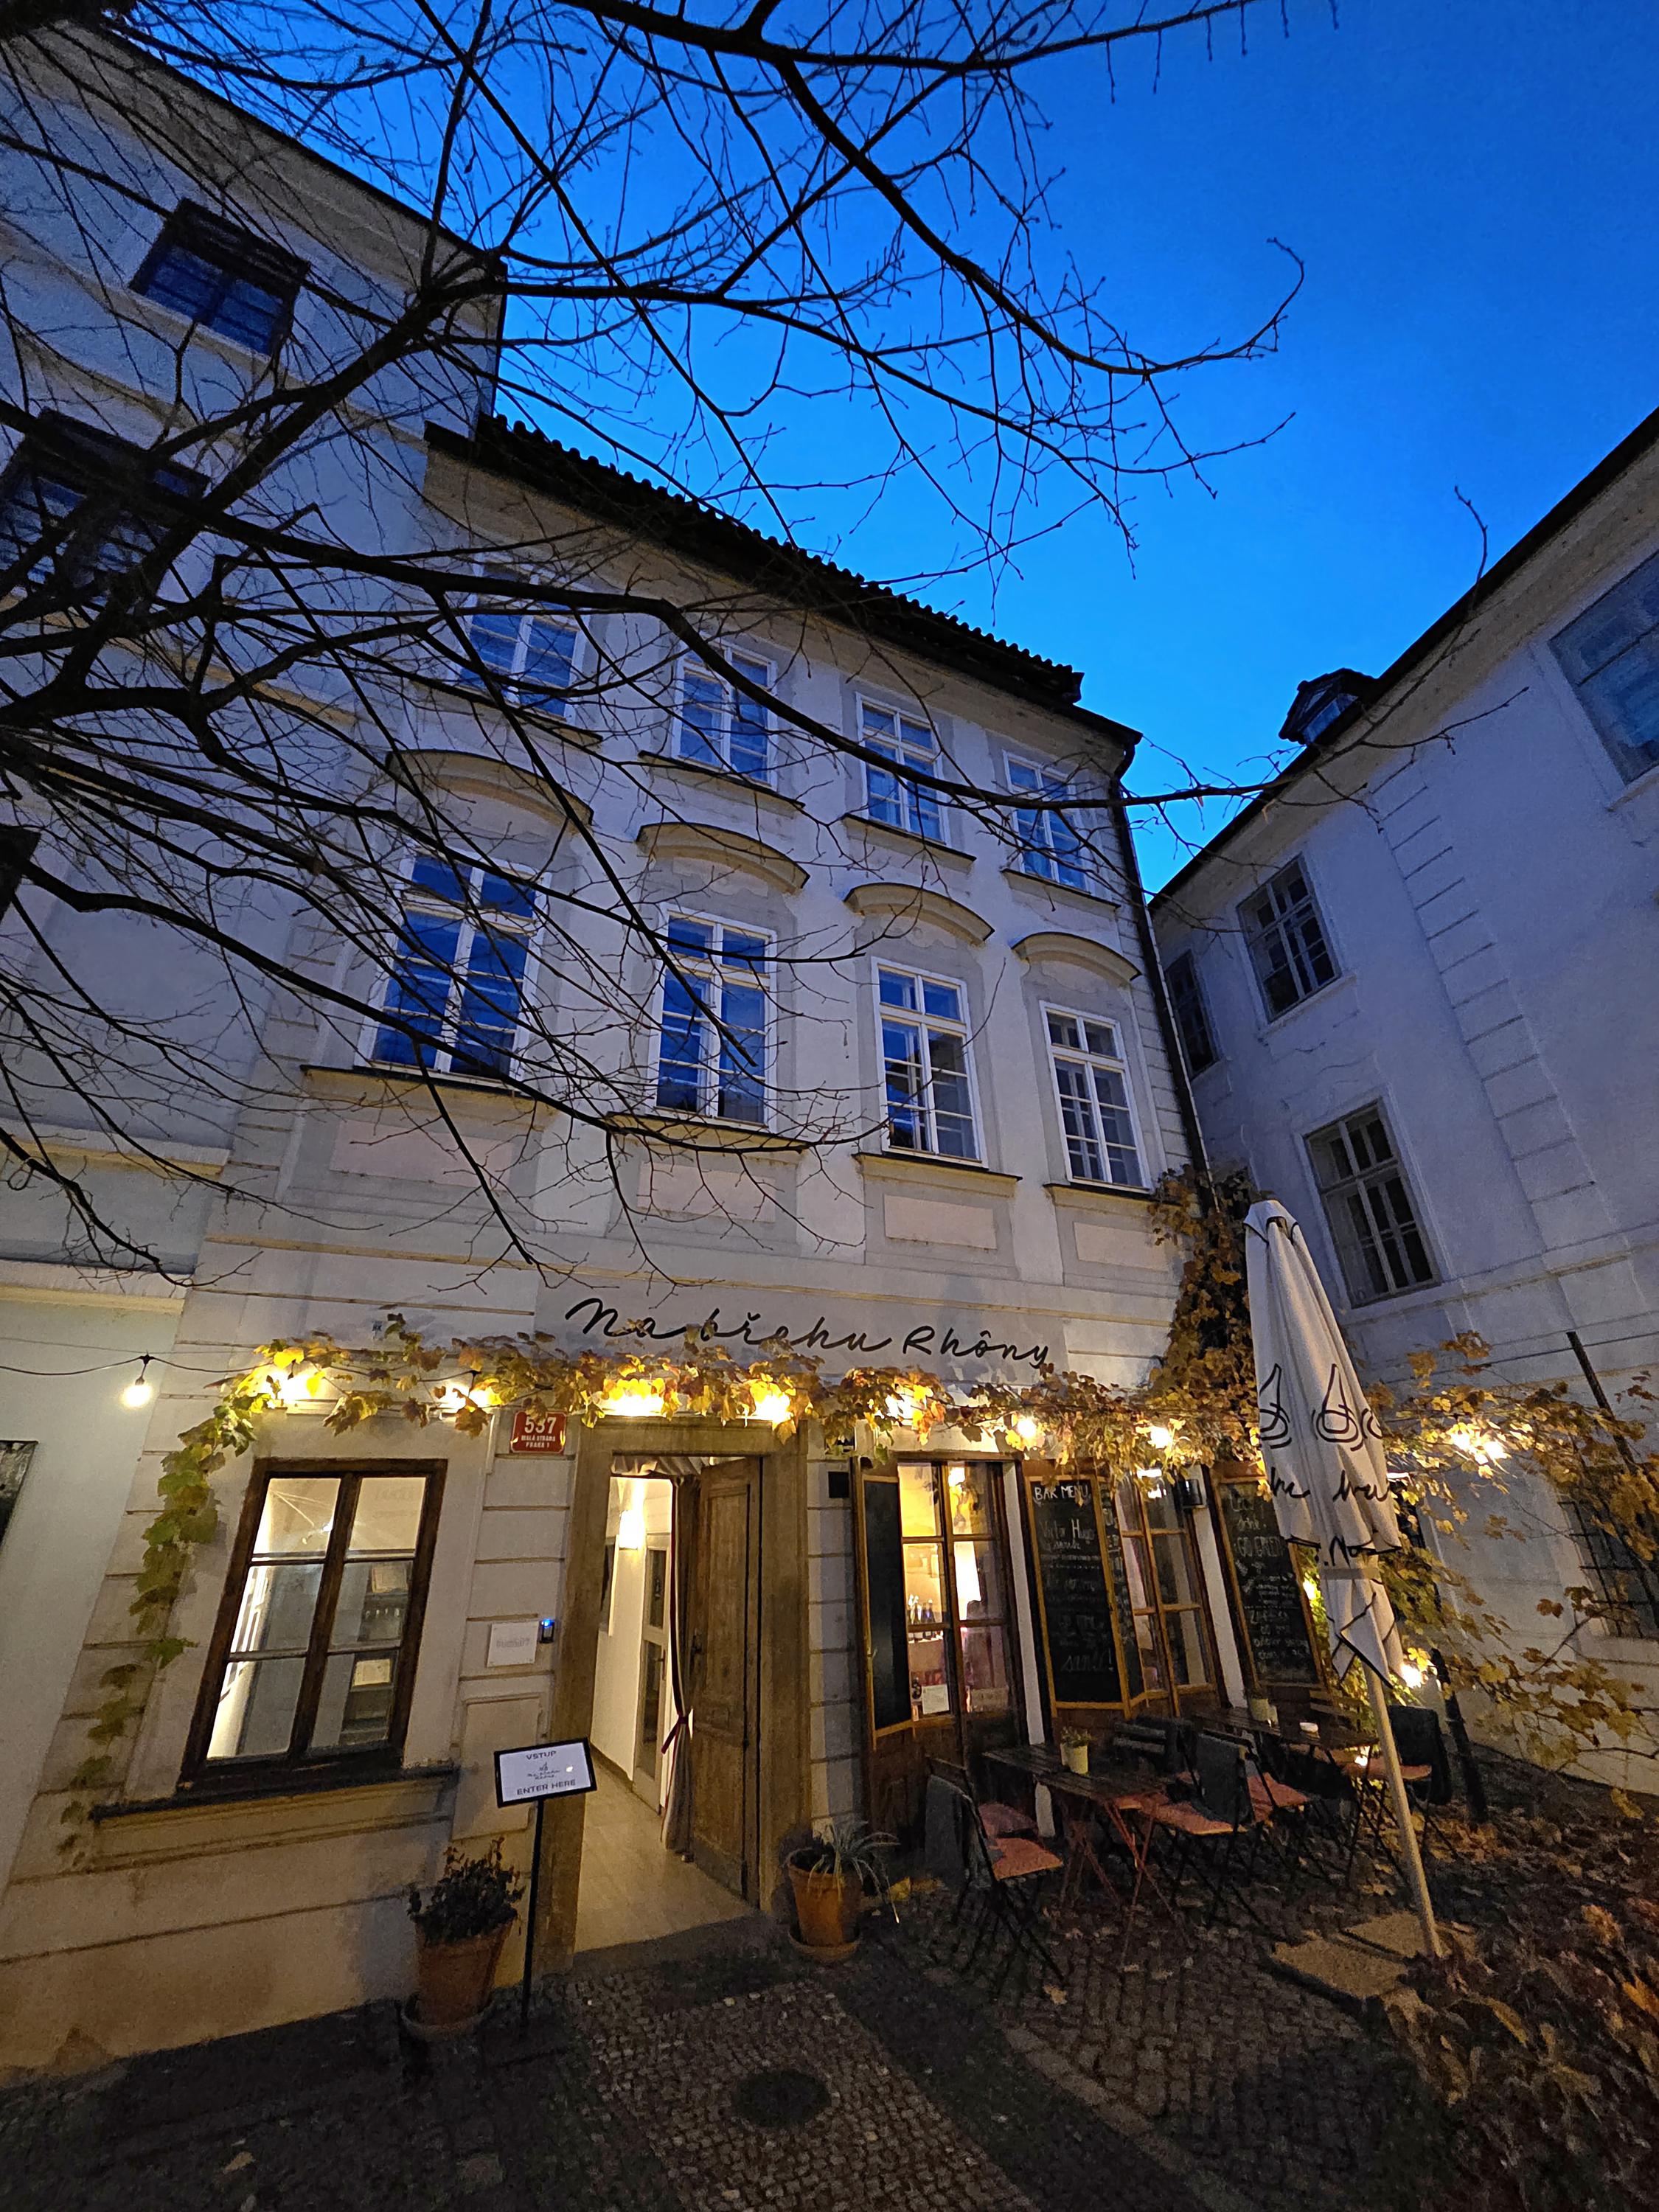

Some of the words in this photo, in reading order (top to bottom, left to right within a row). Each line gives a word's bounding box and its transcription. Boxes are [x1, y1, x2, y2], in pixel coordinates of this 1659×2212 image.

[565, 1297, 685, 1340] Na
[699, 1307, 893, 1352] břehu
[902, 1325, 1049, 1369] Rhôny
[526, 1750, 557, 1760] VSTUP
[516, 1784, 549, 1795] ENTER
[552, 1779, 577, 1790] HERE
